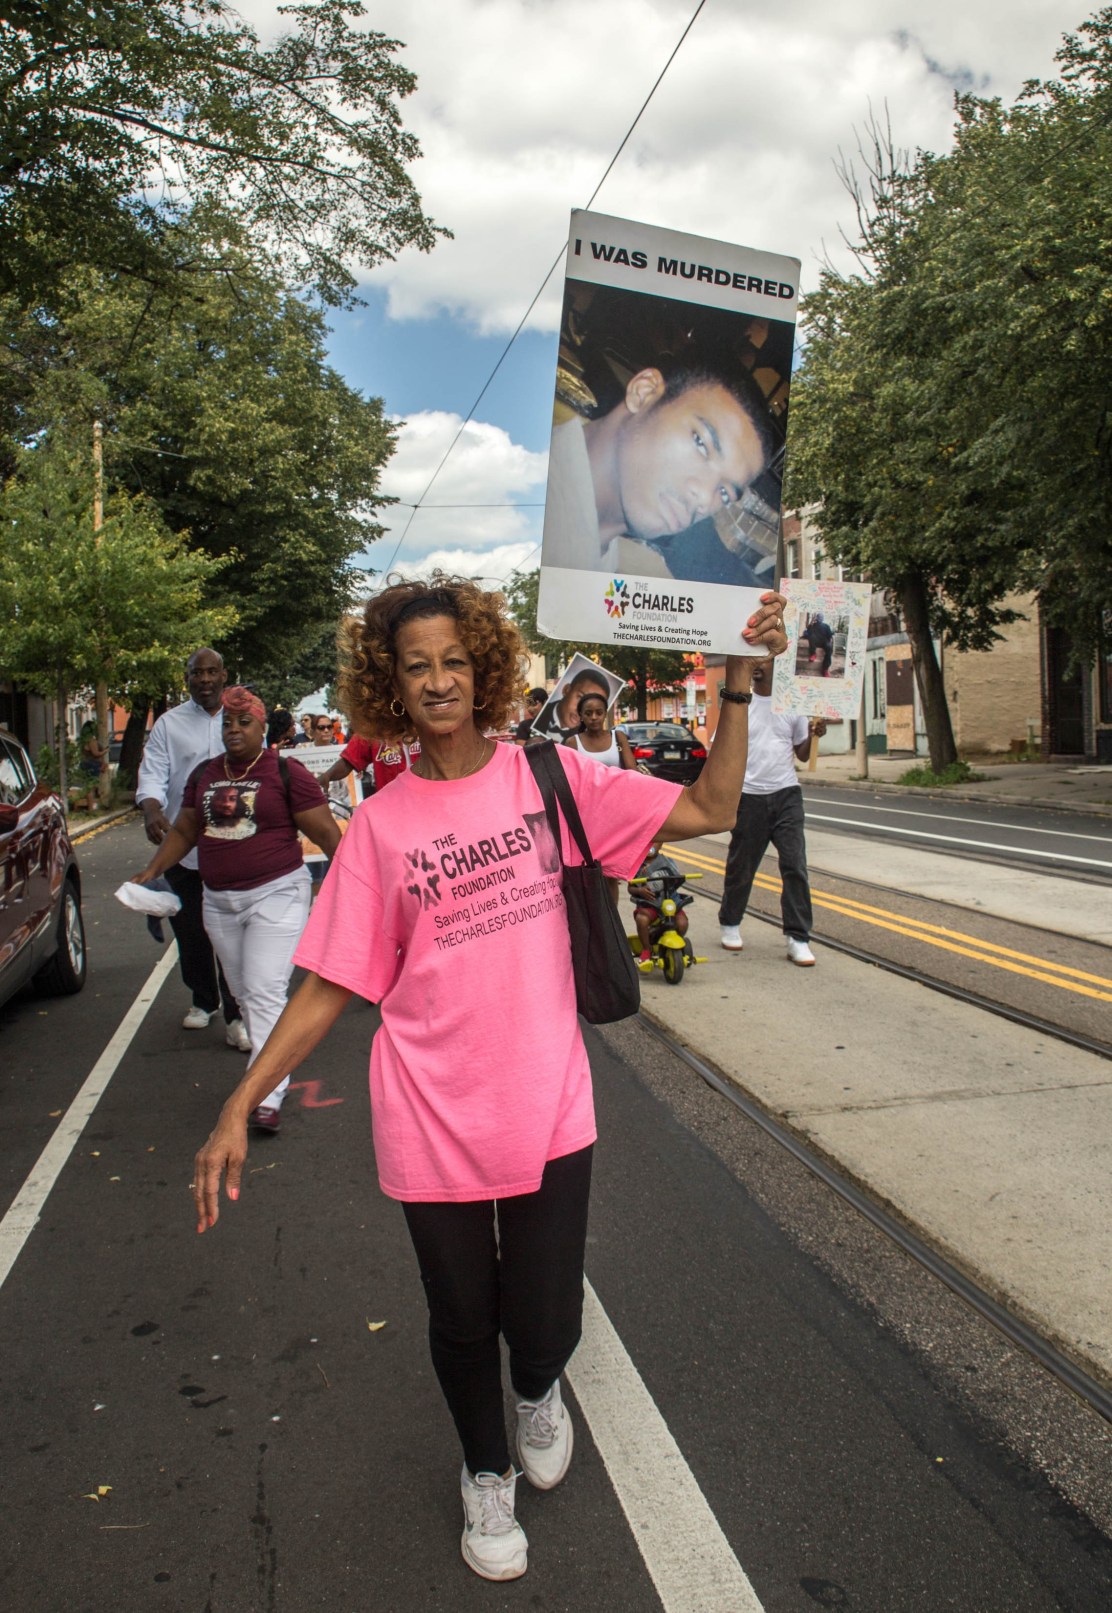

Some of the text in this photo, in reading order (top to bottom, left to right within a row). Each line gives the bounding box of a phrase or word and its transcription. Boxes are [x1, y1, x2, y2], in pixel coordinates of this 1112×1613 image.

[574, 239, 795, 300] I WAS MURDERED
[634, 581, 649, 592] THE
[631, 592, 694, 614] CHARLES
[632, 611, 678, 623] FOUNDATION
[613, 632, 712, 647] THECHARLESFOUNDATION.ORG
[618, 622, 640, 632] Saving
[640, 624, 656, 632] Lives
[664, 626, 691, 636] Creating
[691, 627, 708, 637] Hope
[432, 833, 458, 851] THE
[440, 827, 532, 880] CHARLES
[451, 866, 516, 901] FOUNDATION
[434, 909, 471, 929] Saving
[470, 899, 498, 917] Lives
[500, 891, 509, 905] &
[510, 881, 548, 902] Creating
